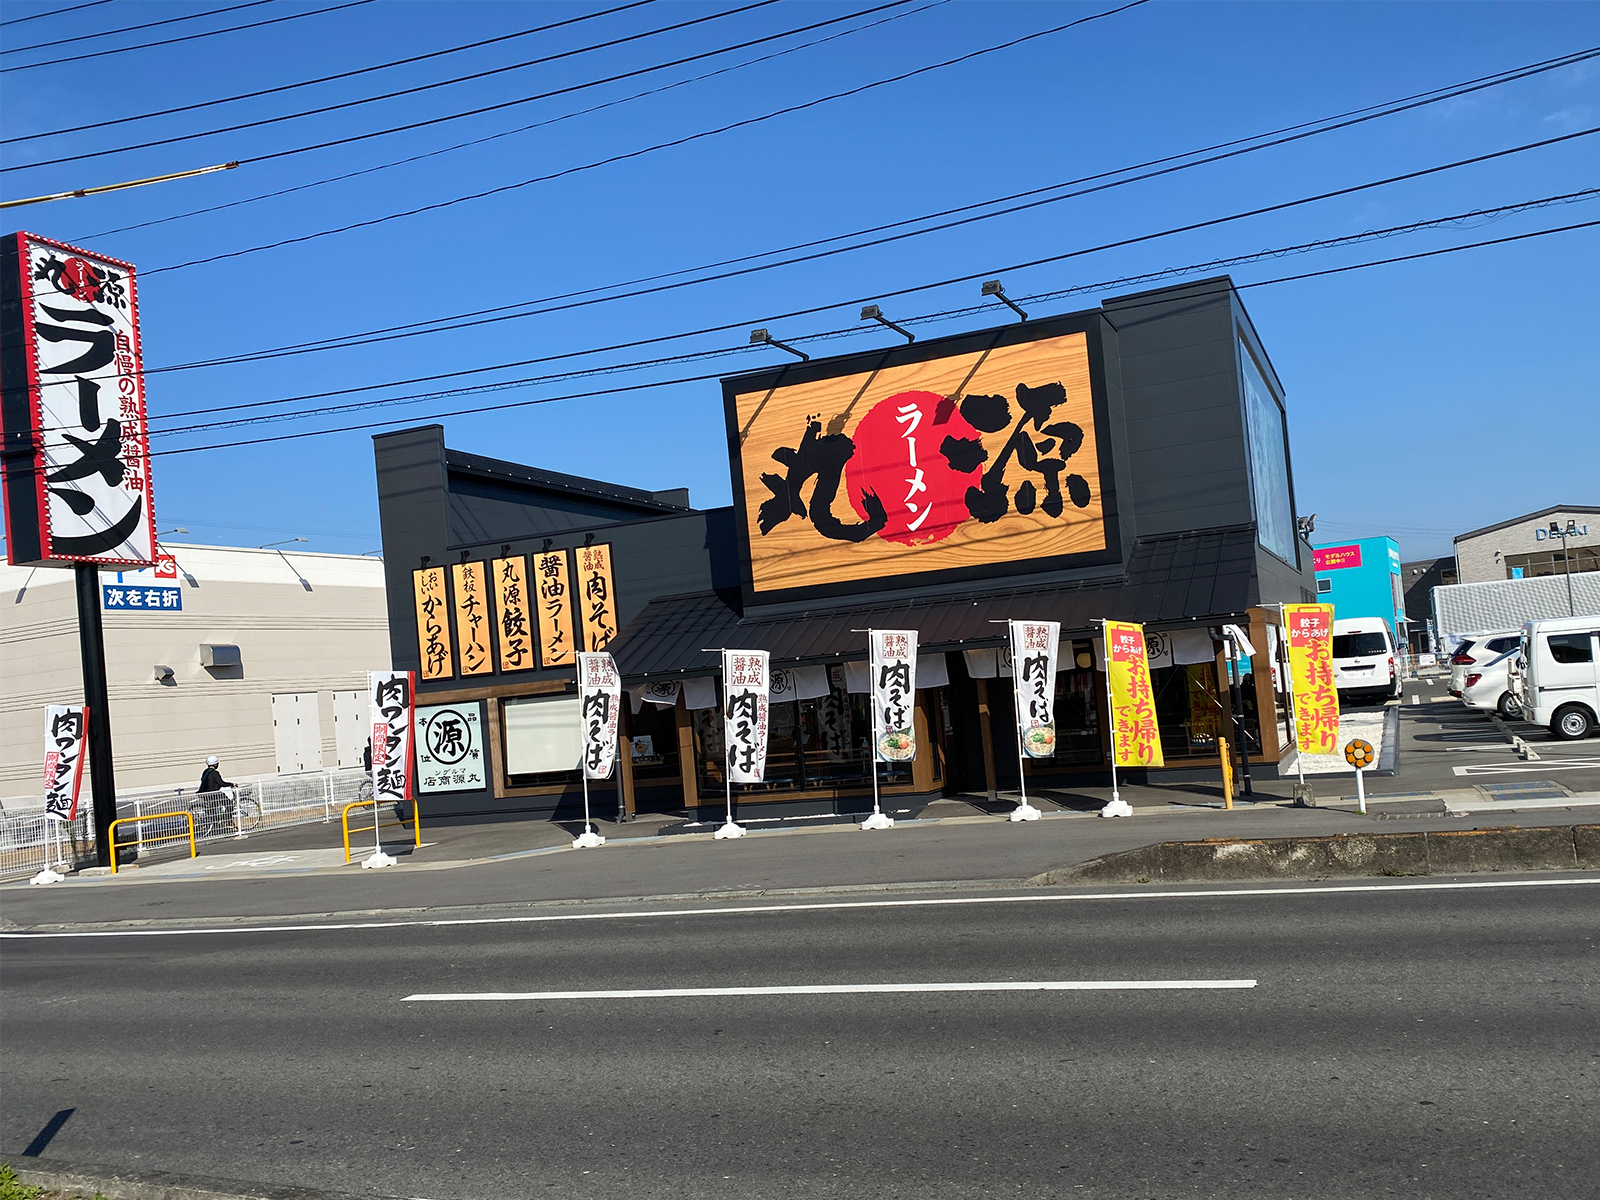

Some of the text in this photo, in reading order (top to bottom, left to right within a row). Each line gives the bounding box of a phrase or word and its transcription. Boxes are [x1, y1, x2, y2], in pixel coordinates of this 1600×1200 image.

[34, 302, 142, 557] ラーメン
[114, 329, 145, 493] 自慢の熟成醤油
[895, 402, 931, 532] ラーメン
[106, 588, 179, 608] 次を右折
[421, 595, 449, 676] からあげ
[501, 561, 529, 666] 丸源餃子
[538, 555, 569, 662] 醤油ラーメン
[1291, 628, 1328, 638] からあげ
[1300, 618, 1320, 628] 餃子
[1113, 643, 1143, 655] からあげ
[1119, 634, 1135, 644] 餃子
[769, 673, 785, 690] 源
[879, 659, 910, 729] 肉そば
[1126, 654, 1158, 765] お持ち帰り
[1304, 638, 1339, 753] お持ち帰り
[433, 718, 465, 757] 源
[583, 689, 611, 770] 肉そば
[726, 688, 760, 773] 肉そば
[1114, 705, 1134, 762] できます
[1295, 693, 1315, 751] できます
